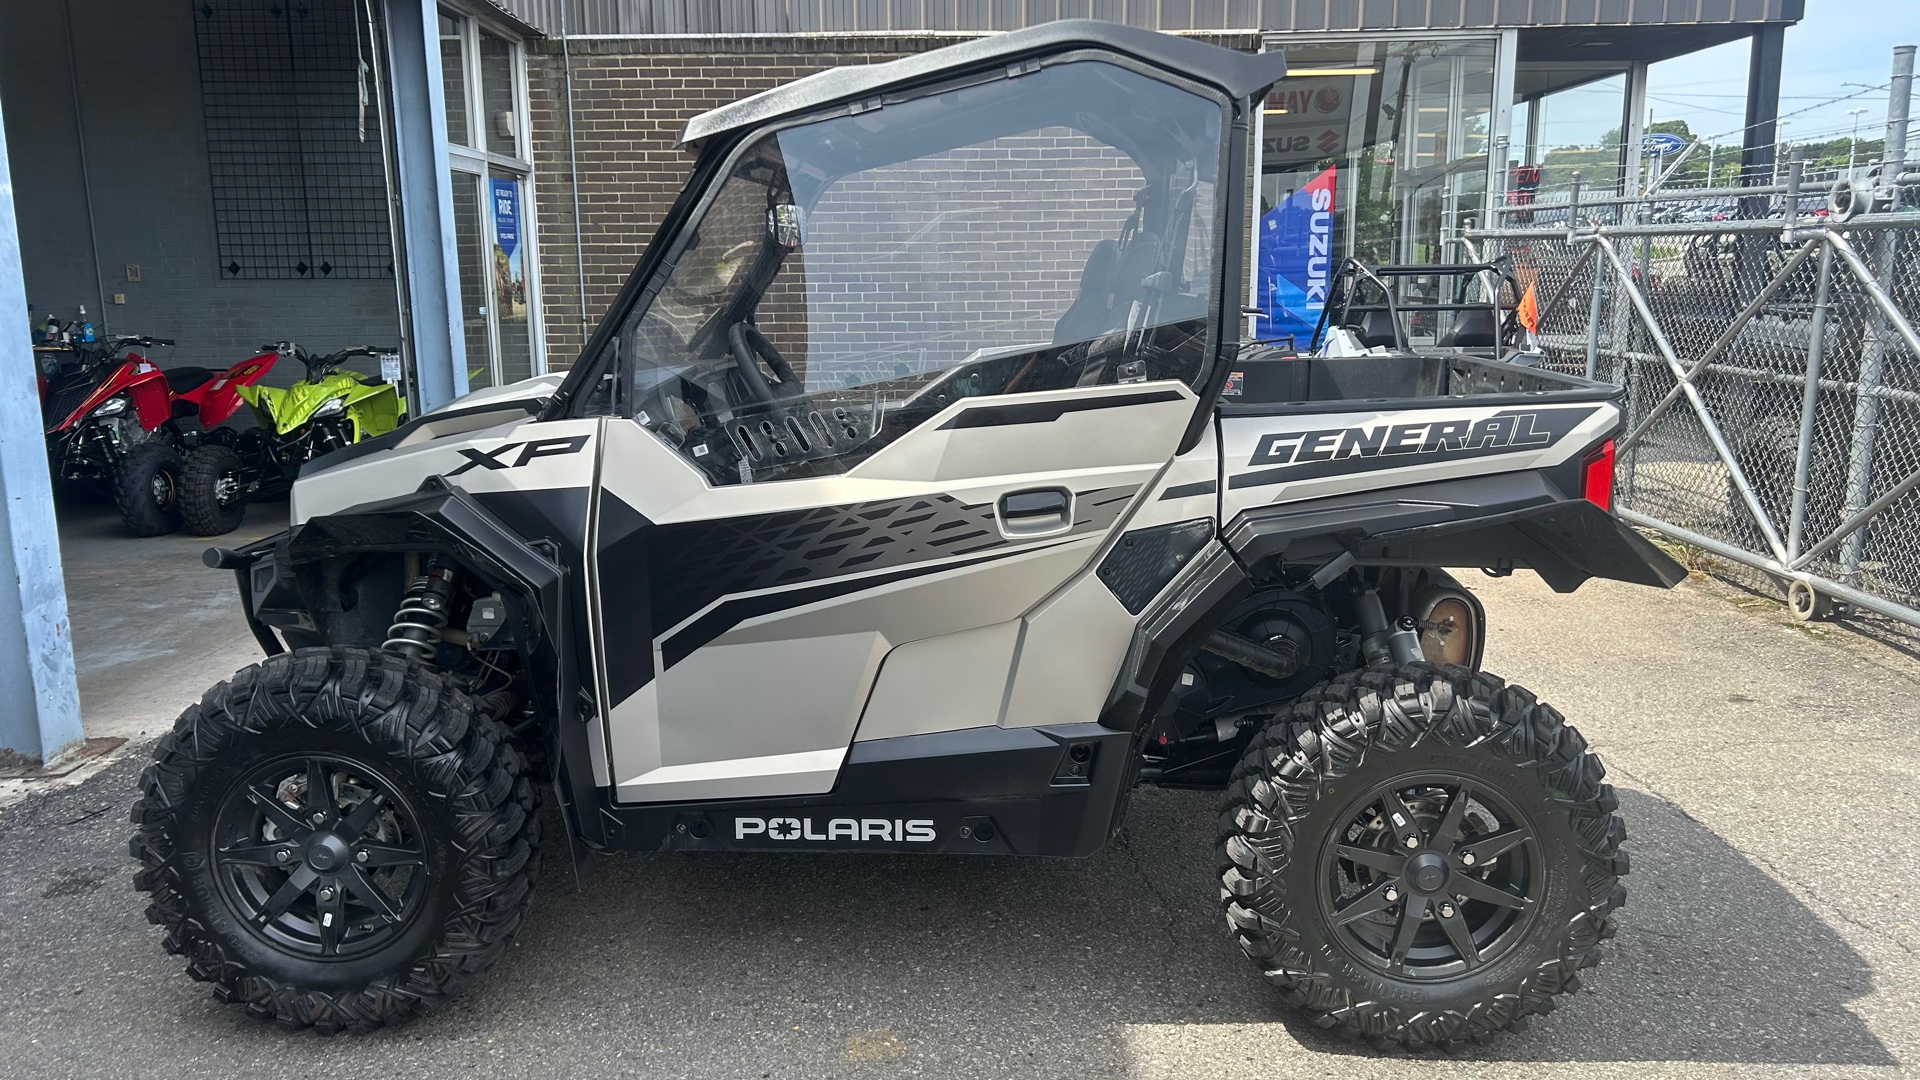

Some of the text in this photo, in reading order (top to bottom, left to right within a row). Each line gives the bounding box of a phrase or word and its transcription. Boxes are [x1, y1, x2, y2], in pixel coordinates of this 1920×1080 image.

[498, 199, 513, 215] RIDE
[1306, 188, 1332, 310] SUZUKI
[443, 435, 591, 477] XP
[1248, 414, 1551, 467] GENERAL
[735, 817, 937, 842] POLARIS
